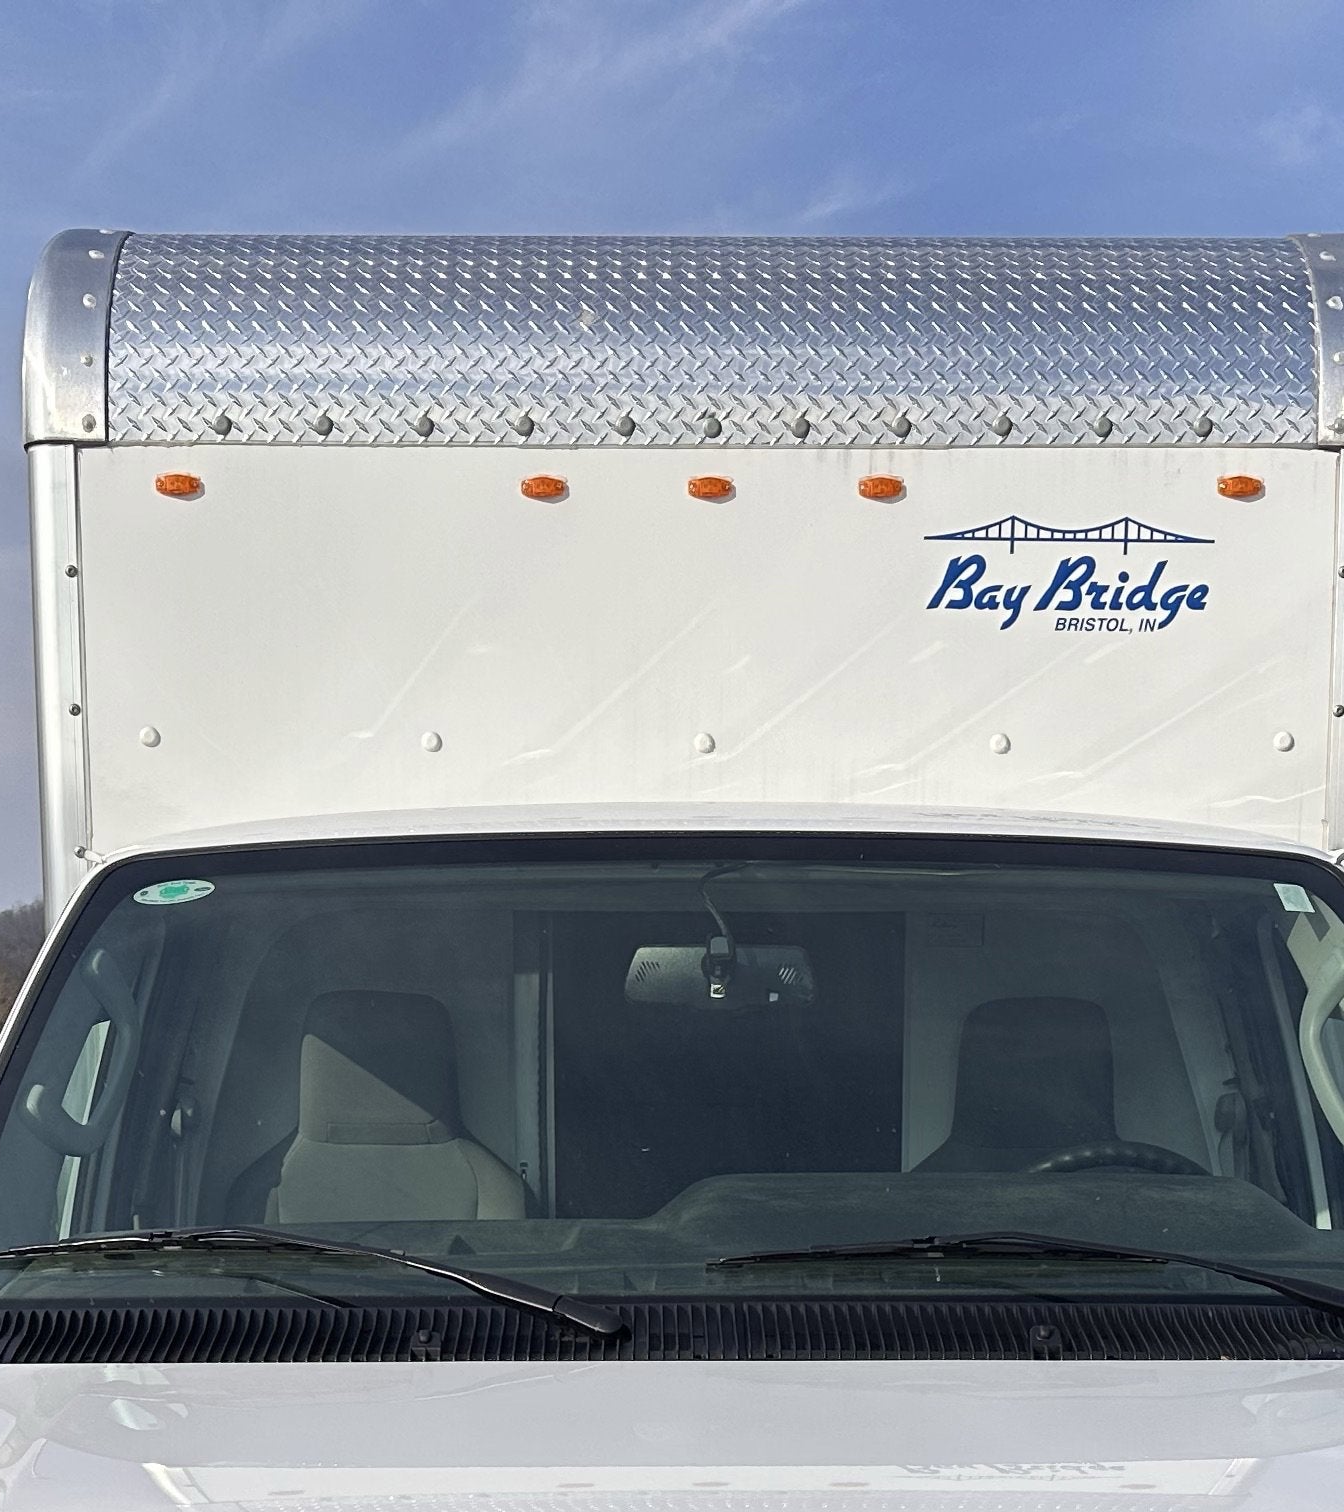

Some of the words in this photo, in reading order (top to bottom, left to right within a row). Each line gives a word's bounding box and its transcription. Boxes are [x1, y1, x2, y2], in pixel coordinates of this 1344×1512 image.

[926, 554, 1031, 630] Bay
[1033, 555, 1210, 630] Bridge
[1054, 617, 1134, 634] BRISTOL,
[1138, 617, 1158, 632] IN
